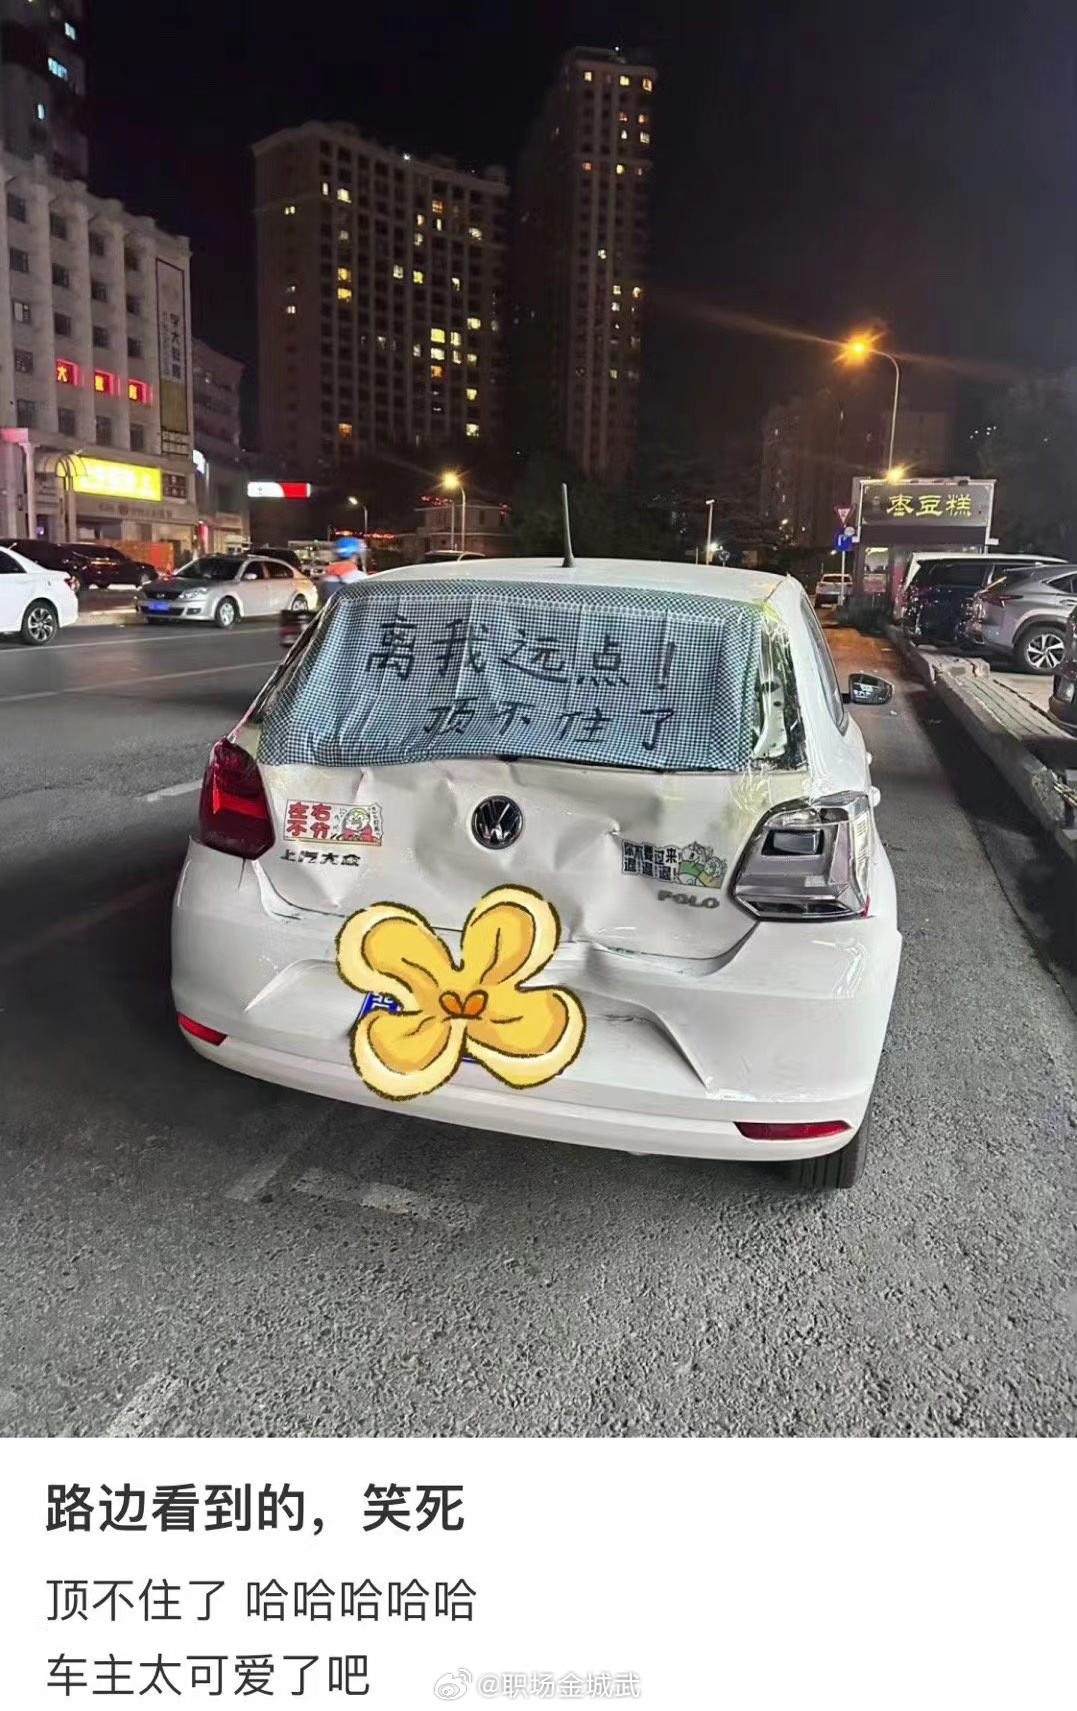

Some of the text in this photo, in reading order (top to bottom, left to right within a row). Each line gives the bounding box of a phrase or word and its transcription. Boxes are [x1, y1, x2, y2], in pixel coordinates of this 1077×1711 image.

[886, 494, 972, 517] 枣豆糕
[366, 614, 677, 690] 离我远点！
[424, 697, 675, 751] 顶不住了
[287, 801, 332, 821] 左右
[286, 819, 331, 839] 不分
[280, 849, 361, 867] 上汽大众
[657, 890, 720, 909] POLO
